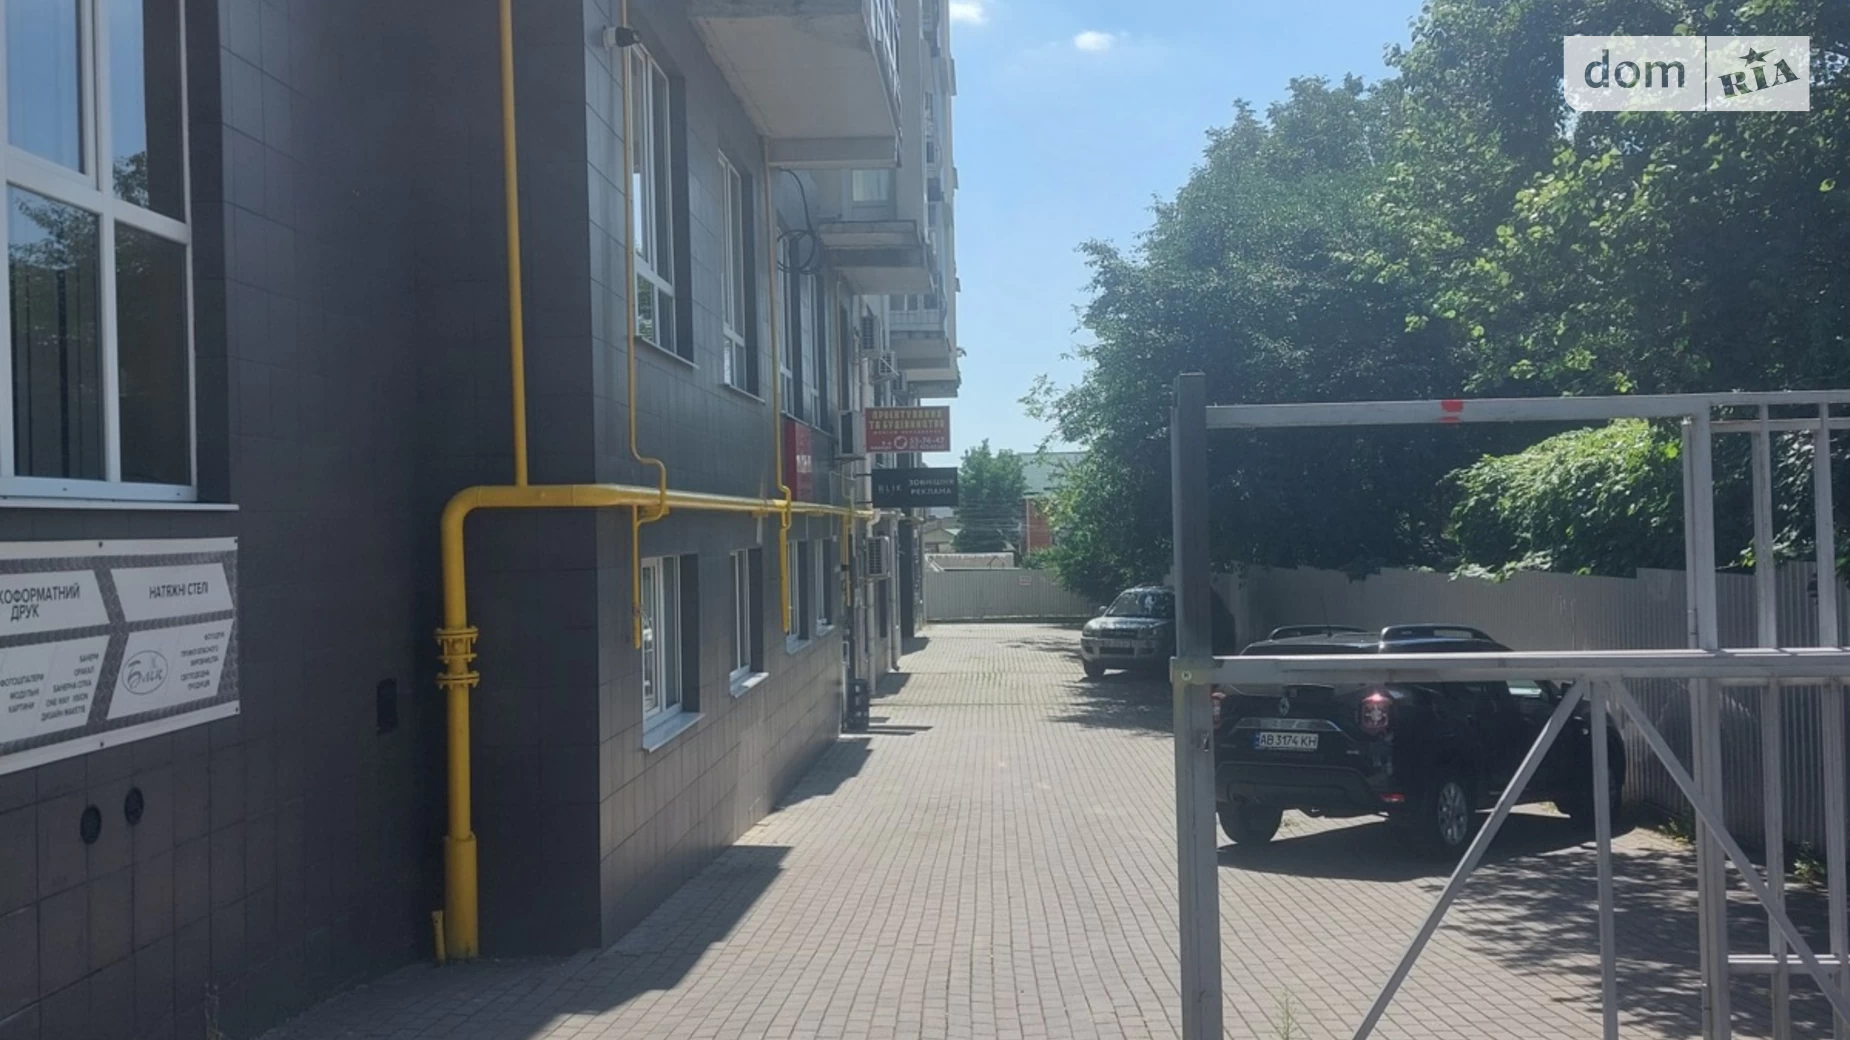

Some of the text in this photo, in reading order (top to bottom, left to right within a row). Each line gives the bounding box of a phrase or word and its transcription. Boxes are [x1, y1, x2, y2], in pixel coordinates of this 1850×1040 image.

[149, 581, 209, 599] НАТЯЖНІ СТЕЛІ
[10, 604, 40, 622] ДРУК
[1275, 734, 1298, 745] 3174
[1300, 735, 1317, 746] KH
